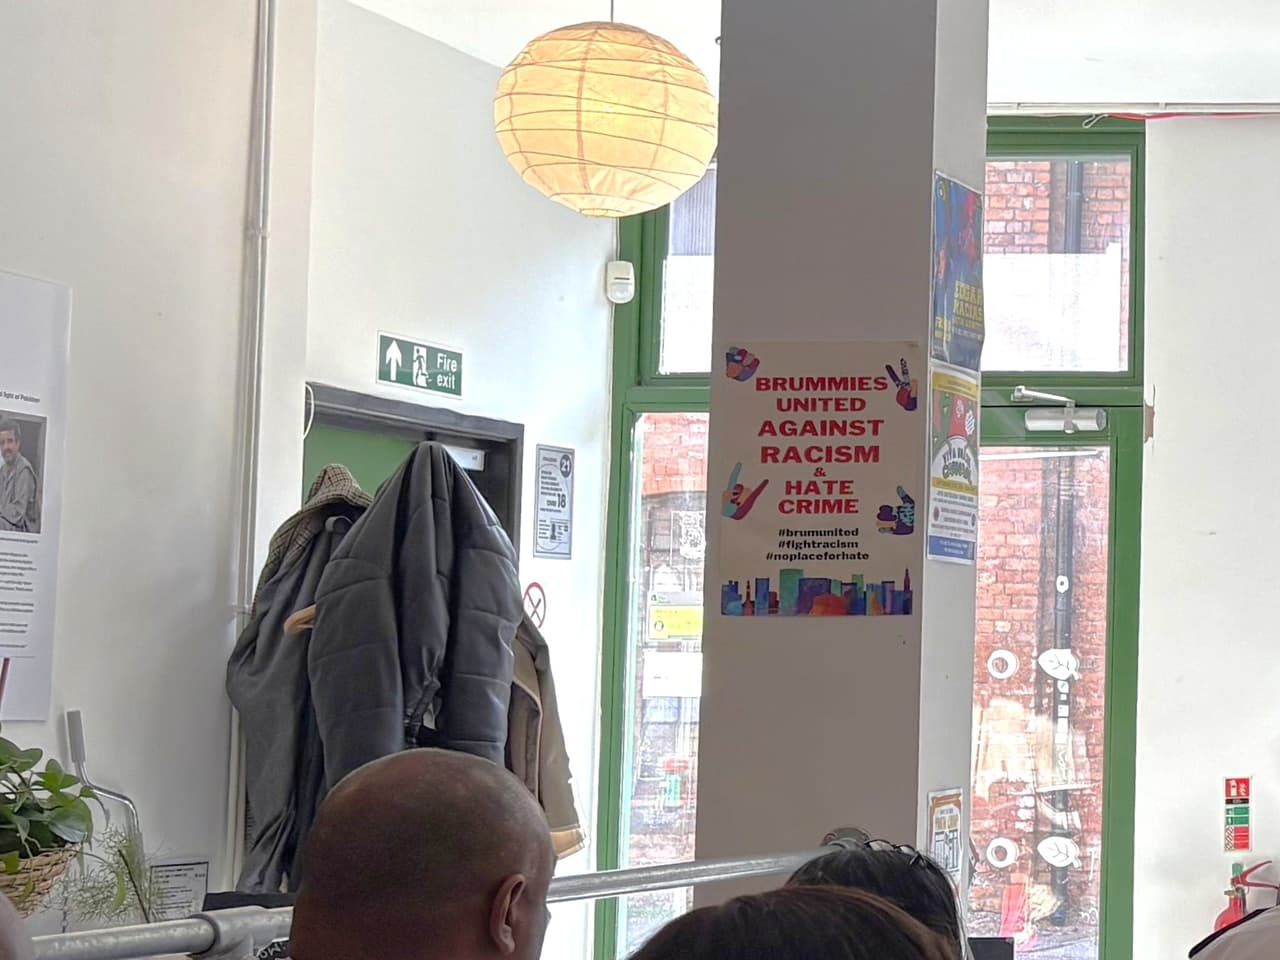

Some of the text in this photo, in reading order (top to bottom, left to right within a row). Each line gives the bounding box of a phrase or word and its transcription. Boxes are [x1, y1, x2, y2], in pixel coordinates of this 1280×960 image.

[437, 353, 457, 372] Fire
[437, 373, 455, 389] exit
[755, 376, 889, 392] BRUMMIES
[776, 397, 866, 412] UNITED
[758, 419, 885, 437] AGAINST
[760, 445, 880, 464] RACISM
[813, 467, 827, 478] &
[785, 480, 854, 495] HATE
[557, 493, 566, 508] 18
[778, 499, 859, 514] CRIME
[778, 527, 859, 537] #brumunited
[778, 539, 859, 550] #fightracism
[766, 551, 869, 562] #noplaceforhate
